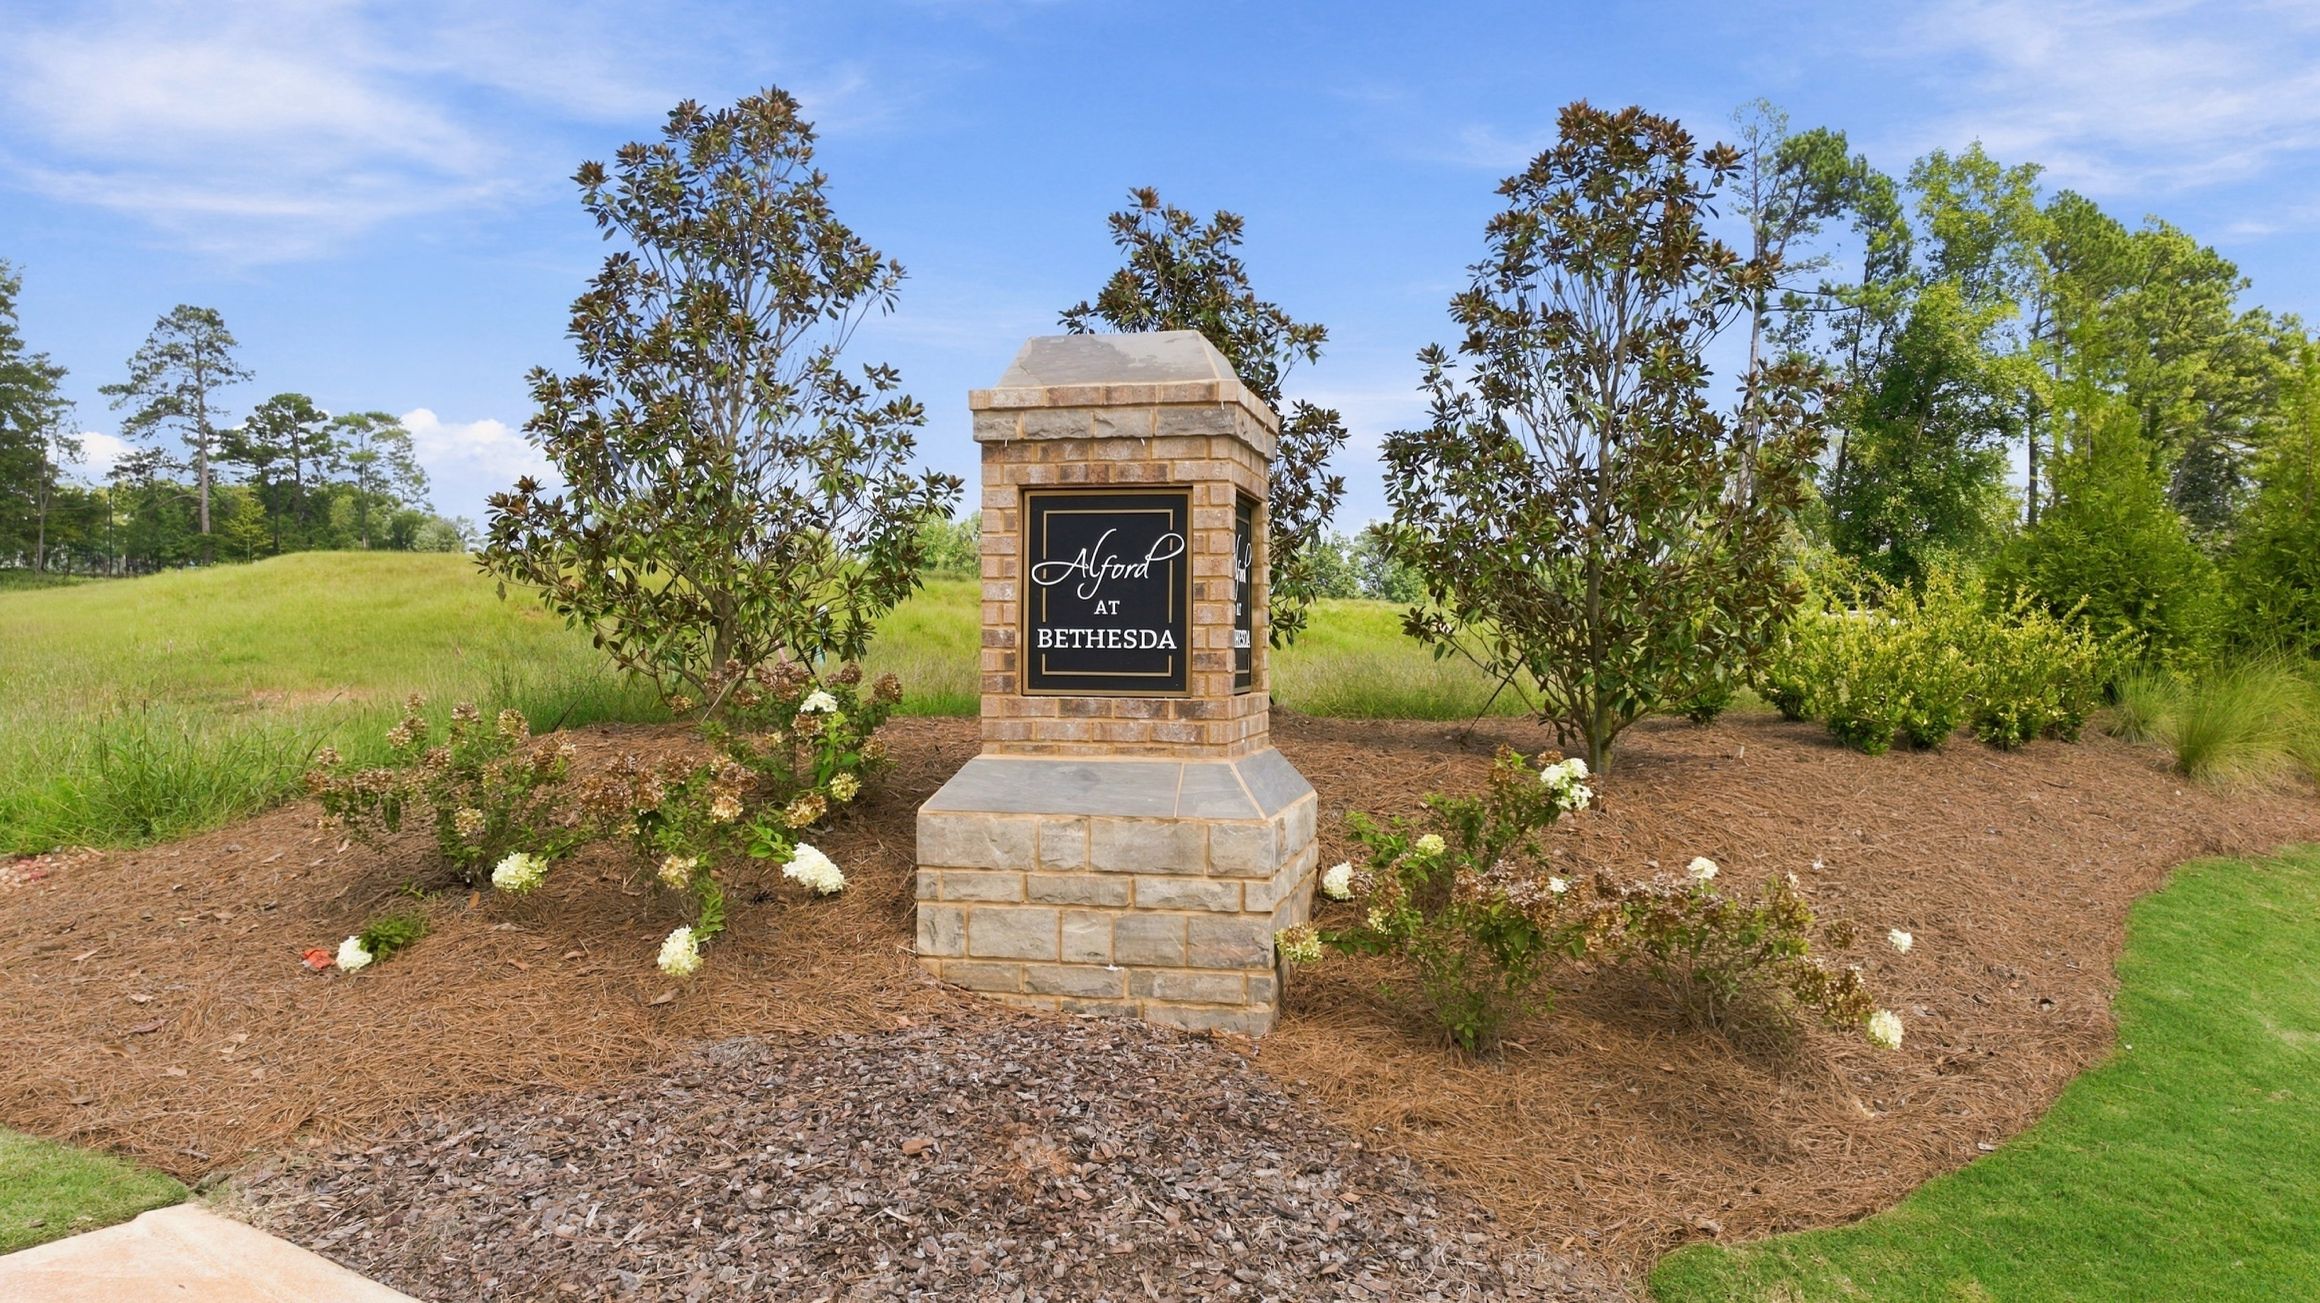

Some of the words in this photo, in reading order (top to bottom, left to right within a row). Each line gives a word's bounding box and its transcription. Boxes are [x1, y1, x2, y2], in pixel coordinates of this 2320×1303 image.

[1031, 528, 1185, 600] Alford
[1094, 600, 1120, 615] AT
[1036, 628, 1177, 650] BETHESDA
